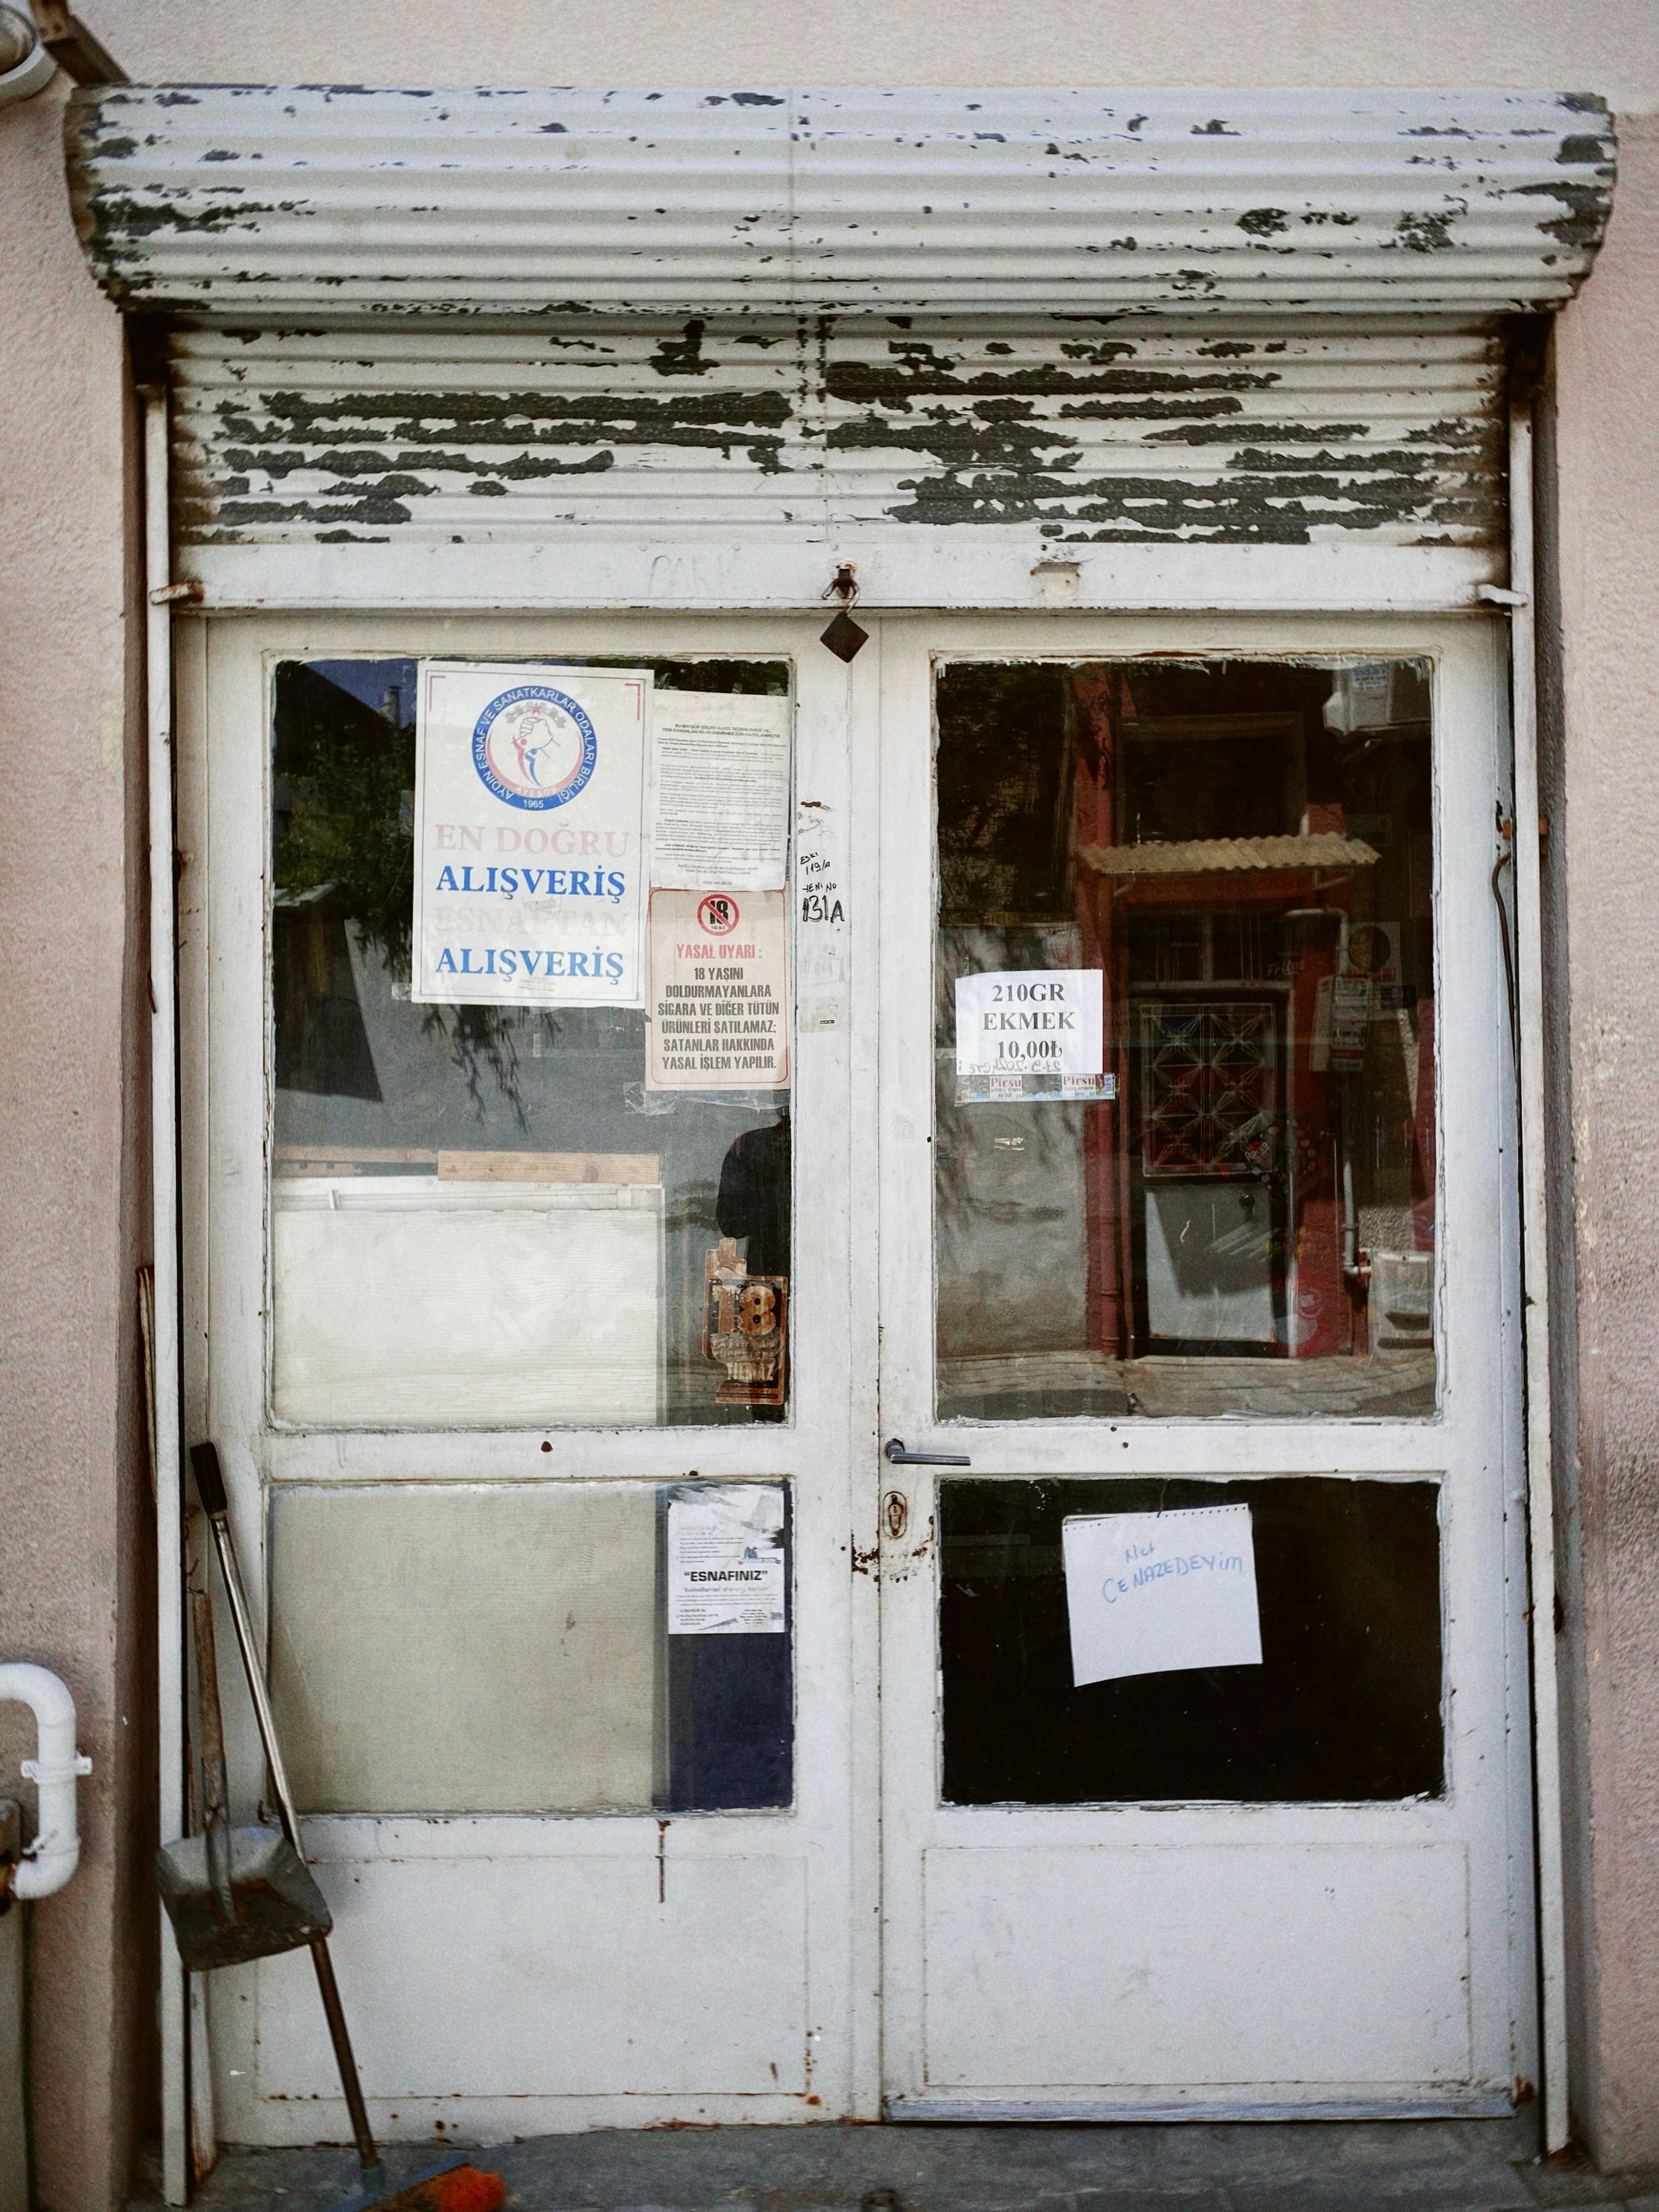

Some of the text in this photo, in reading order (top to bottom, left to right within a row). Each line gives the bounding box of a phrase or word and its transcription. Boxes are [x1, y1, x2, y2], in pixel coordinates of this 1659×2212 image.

[494, 687, 577, 713] SANATKARLAR
[482, 711, 496, 726] VE
[575, 711, 596, 767] ODALARI
[475, 728, 488, 770] ESNAF
[483, 773, 515, 800] AYDIN
[523, 799, 544, 809] 1965
[434, 824, 483, 850] EN
[496, 822, 630, 857] DOĞRU
[436, 865, 626, 904] ALIŞVERİŞ
[435, 905, 626, 938] ESNAFTAN
[710, 900, 729, 925] 18
[676, 944, 716, 959] YASAL
[718, 944, 756, 959] UYARI
[435, 945, 624, 985] ALIŞVERİŞ
[694, 967, 744, 983] 18 YAŞINI
[665, 984, 772, 999] DOLDURMAYANLARA
[992, 983, 1065, 1002] 210GR
[658, 1000, 780, 1016] SİGARA VE DİĞER TÜTÜN
[662, 1018, 777, 1036] ÜRÜNLERİ SATILAMAZ;
[983, 1012, 1076, 1031] EKMEK
[663, 1037, 775, 1052] SATANLAR HAKKINDA
[662, 1053, 777, 1073] YASAL İŞLEM YAPILIR.
[990, 1077, 1022, 1087] Pirsu
[1063, 1075, 1097, 1086] Pirsu
